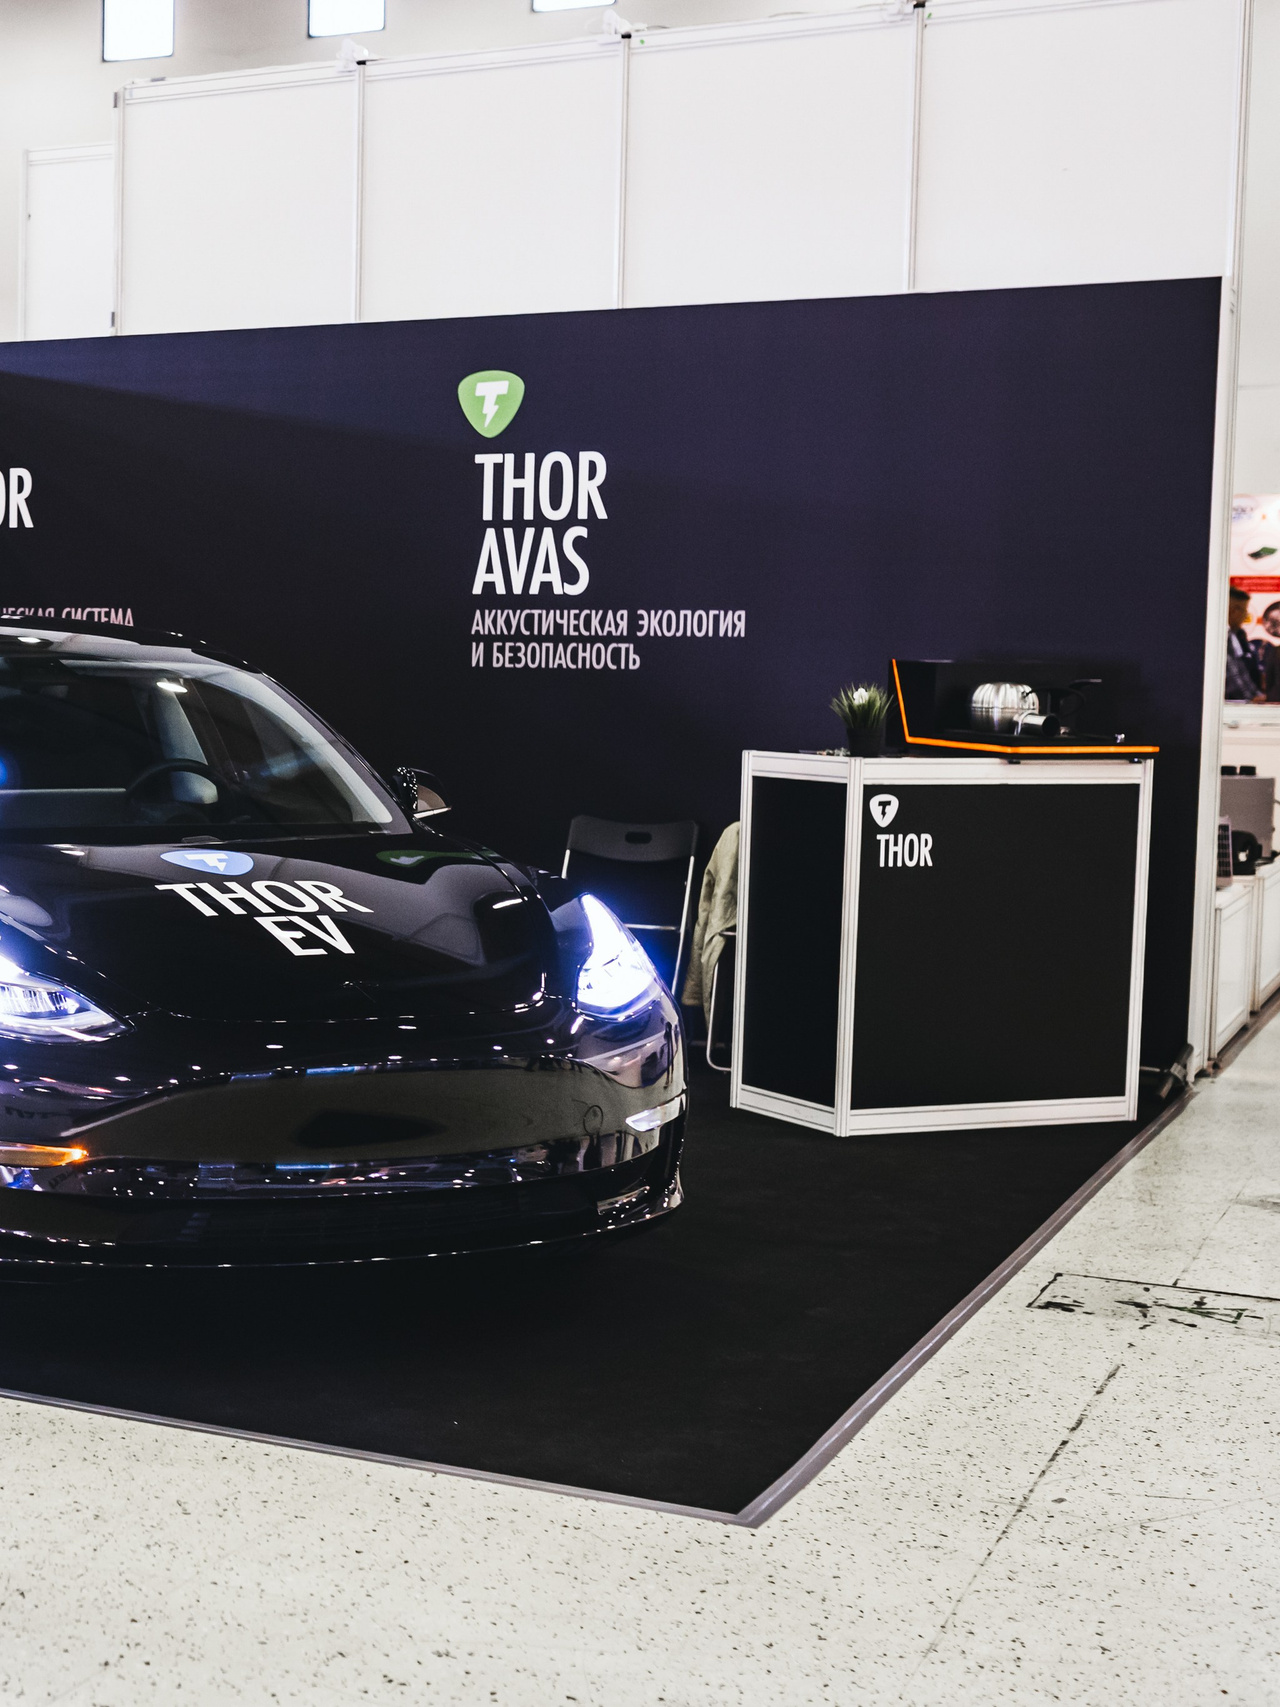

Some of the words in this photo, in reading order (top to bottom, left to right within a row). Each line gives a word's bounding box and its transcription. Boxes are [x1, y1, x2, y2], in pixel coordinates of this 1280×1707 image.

[474, 451, 608, 521] THOR
[472, 526, 590, 596] AVAS
[470, 609, 628, 637] АККУСТИЧЕСКАЯ
[636, 609, 747, 638] ЭКОЛОГИЯ
[471, 642, 484, 668] И
[492, 642, 641, 671] БЕЗОПАСНОСТЬ
[876, 832, 933, 868] THOR
[154, 880, 374, 917] THOR
[253, 914, 355, 956] EV
